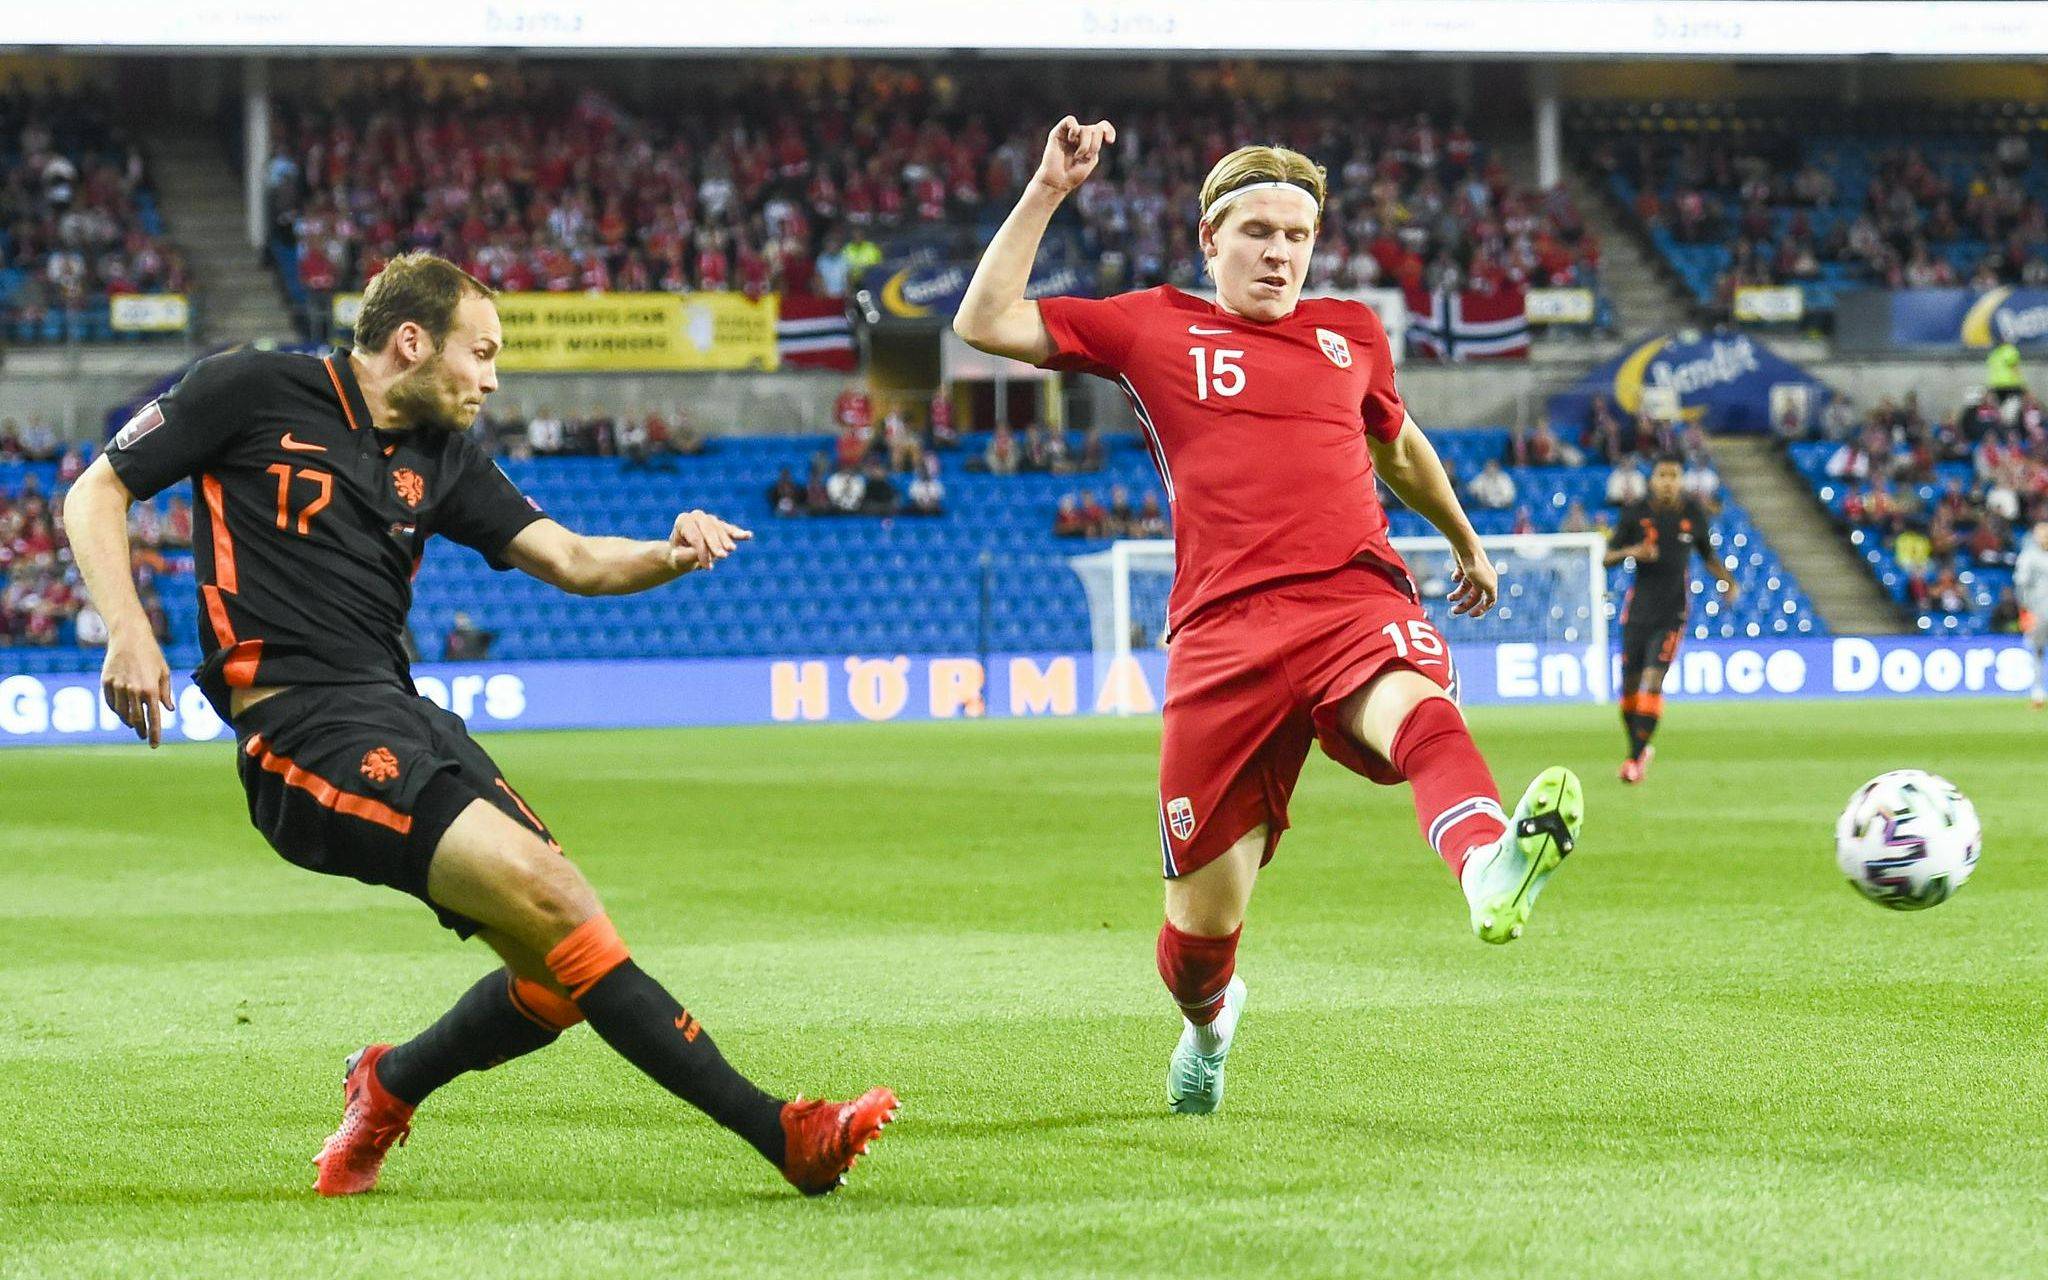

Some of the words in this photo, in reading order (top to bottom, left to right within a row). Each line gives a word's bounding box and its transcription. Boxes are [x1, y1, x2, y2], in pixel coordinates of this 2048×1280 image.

[1188, 346, 1247, 401] 15
[265, 462, 333, 536] 17
[1381, 619, 1443, 658] 15
[1495, 642, 1807, 697] Entnce
[1831, 637, 2036, 693] Doors
[413, 673, 527, 720] ors
[770, 654, 1157, 722] HÖRMA
